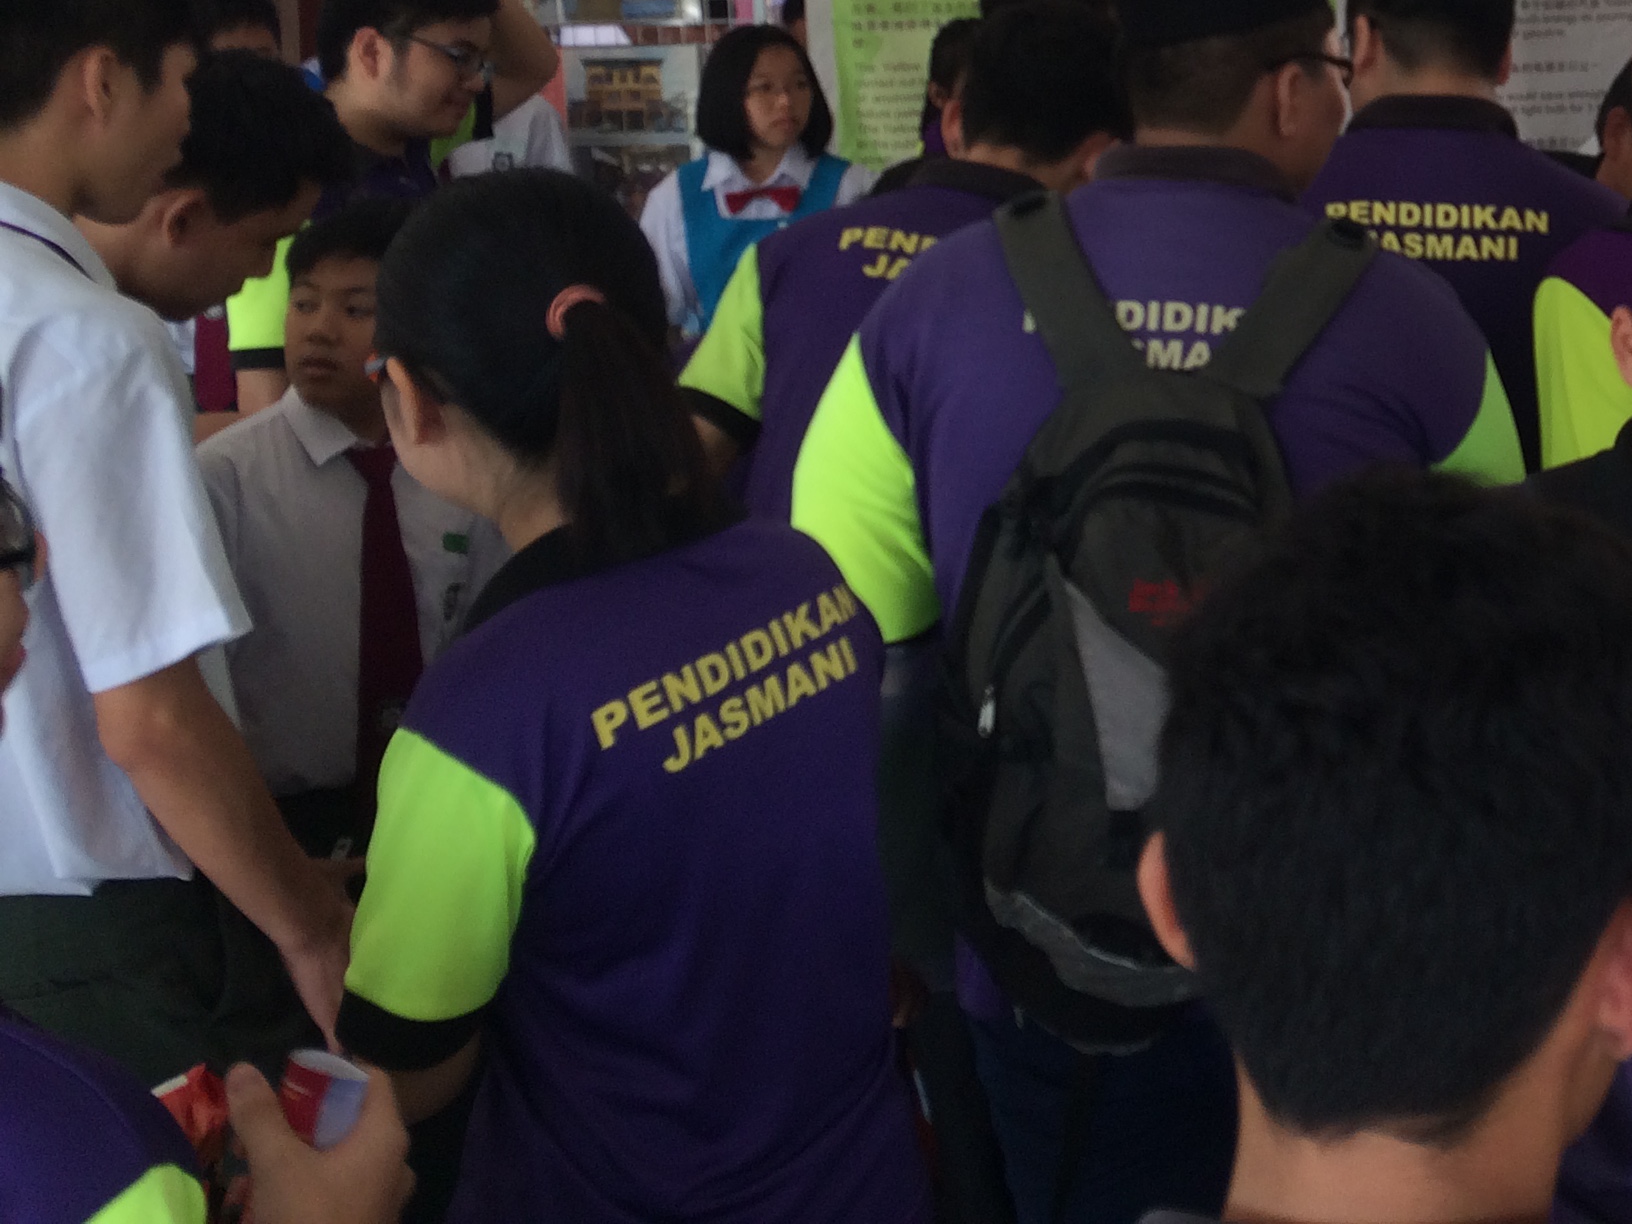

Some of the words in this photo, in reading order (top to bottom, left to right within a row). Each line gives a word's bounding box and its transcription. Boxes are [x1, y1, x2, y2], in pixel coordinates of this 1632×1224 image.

[1325, 200, 1550, 235] PENDIDIKAN
[1368, 229, 1519, 262] ASMANI
[663, 636, 858, 774] JASMANI
